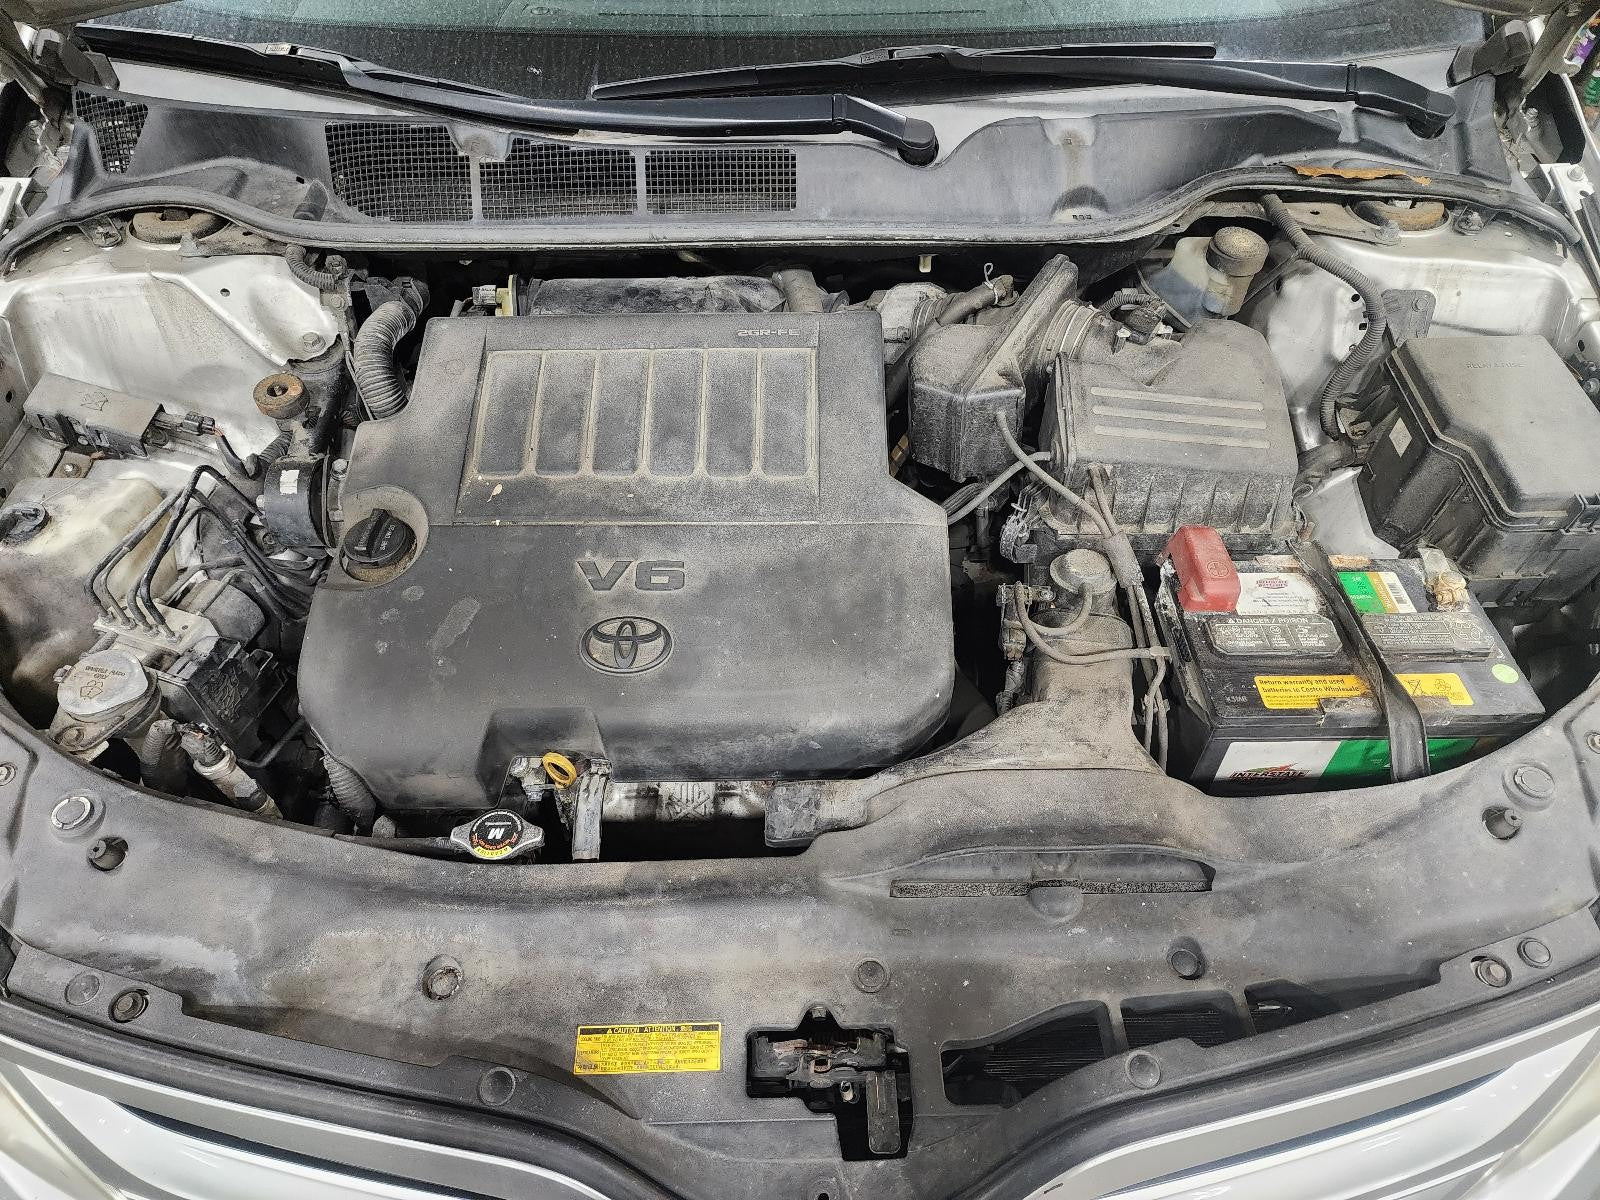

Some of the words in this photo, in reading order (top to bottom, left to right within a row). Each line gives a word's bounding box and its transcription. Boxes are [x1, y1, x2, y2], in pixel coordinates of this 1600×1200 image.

[737, 328, 801, 337] 2GR-FE
[576, 559, 686, 592] V6
[1235, 617, 1270, 625] DANGER
[1283, 679, 1314, 687] warranty
[613, 1026, 640, 1034] CAUTION
[643, 1025, 676, 1033] ATTENTION
